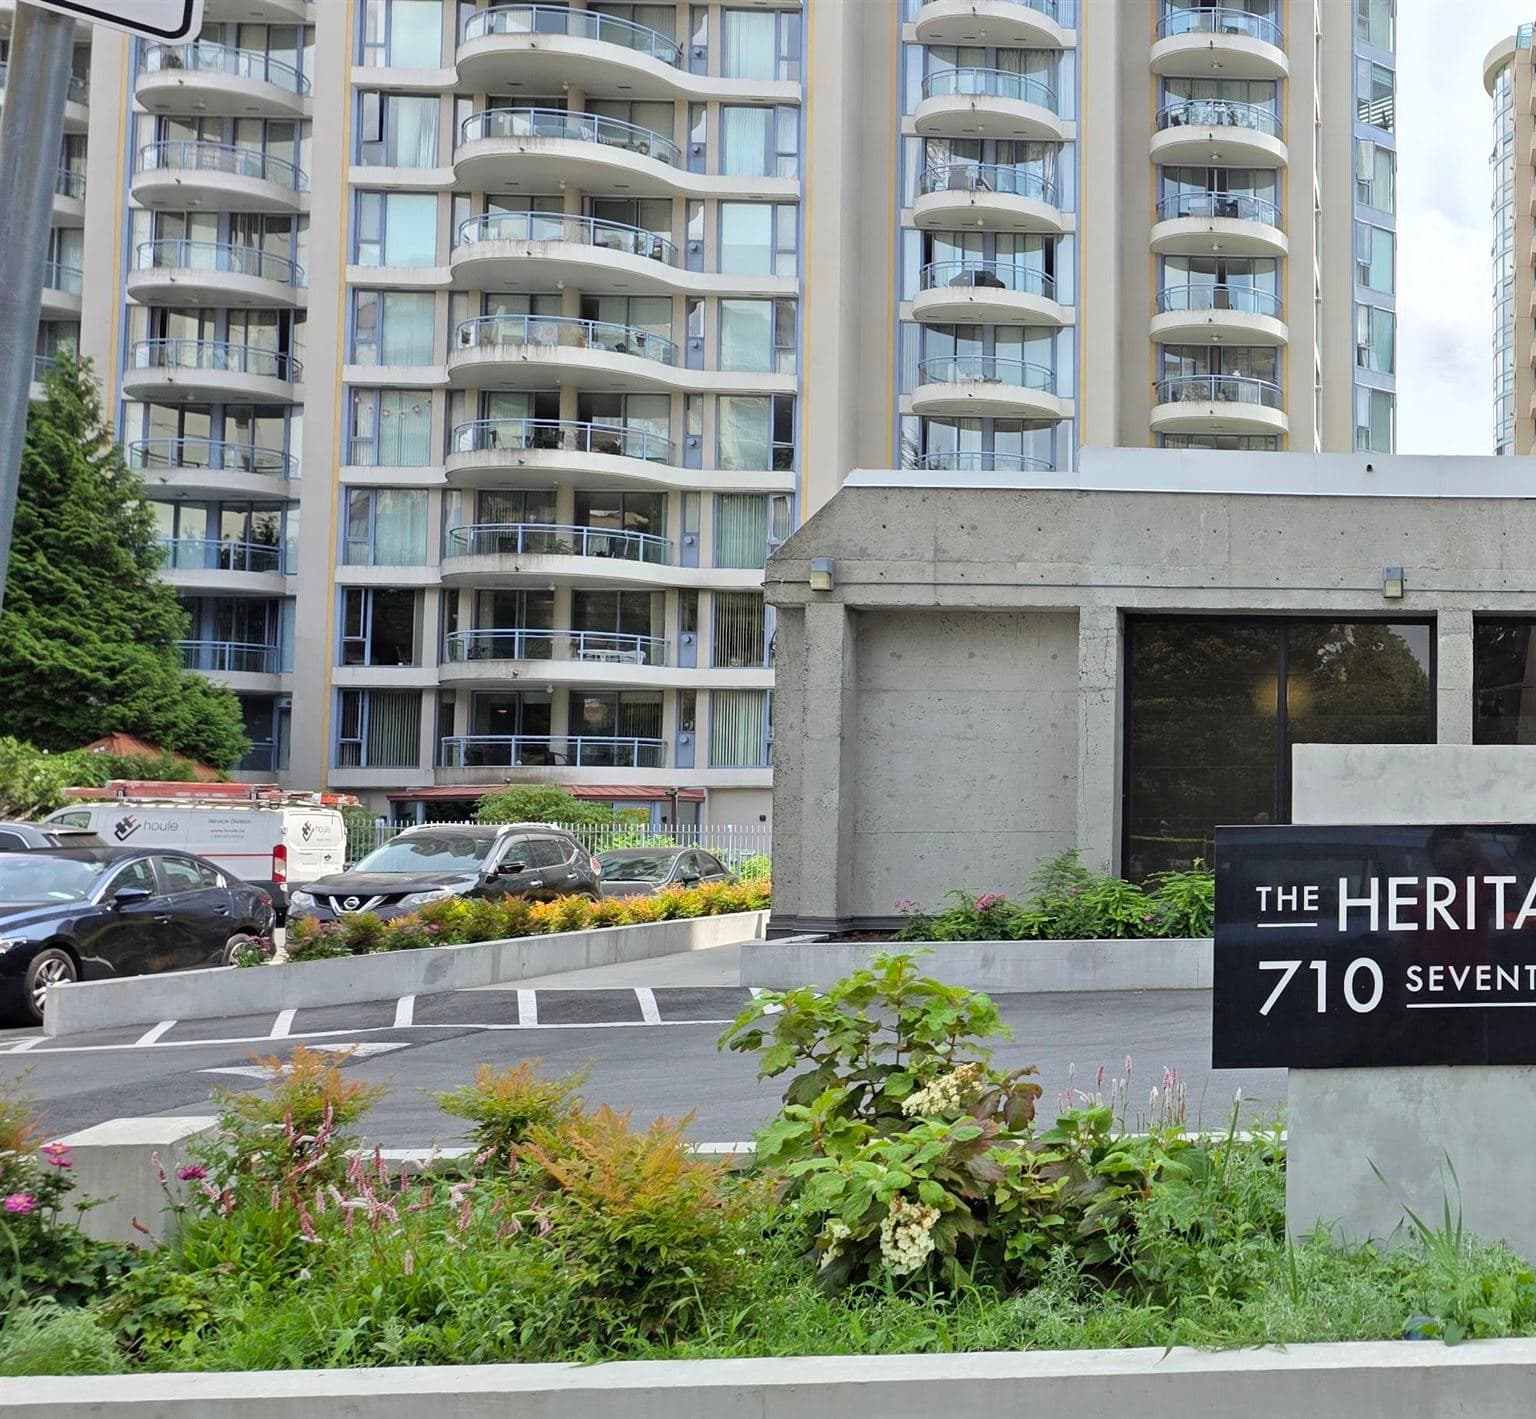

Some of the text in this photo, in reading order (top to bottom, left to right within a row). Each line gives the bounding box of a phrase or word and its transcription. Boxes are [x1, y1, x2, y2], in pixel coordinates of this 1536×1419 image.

[144, 820, 179, 832] houle
[1256, 886, 1319, 912] THE
[1258, 957, 1384, 1016] 710
